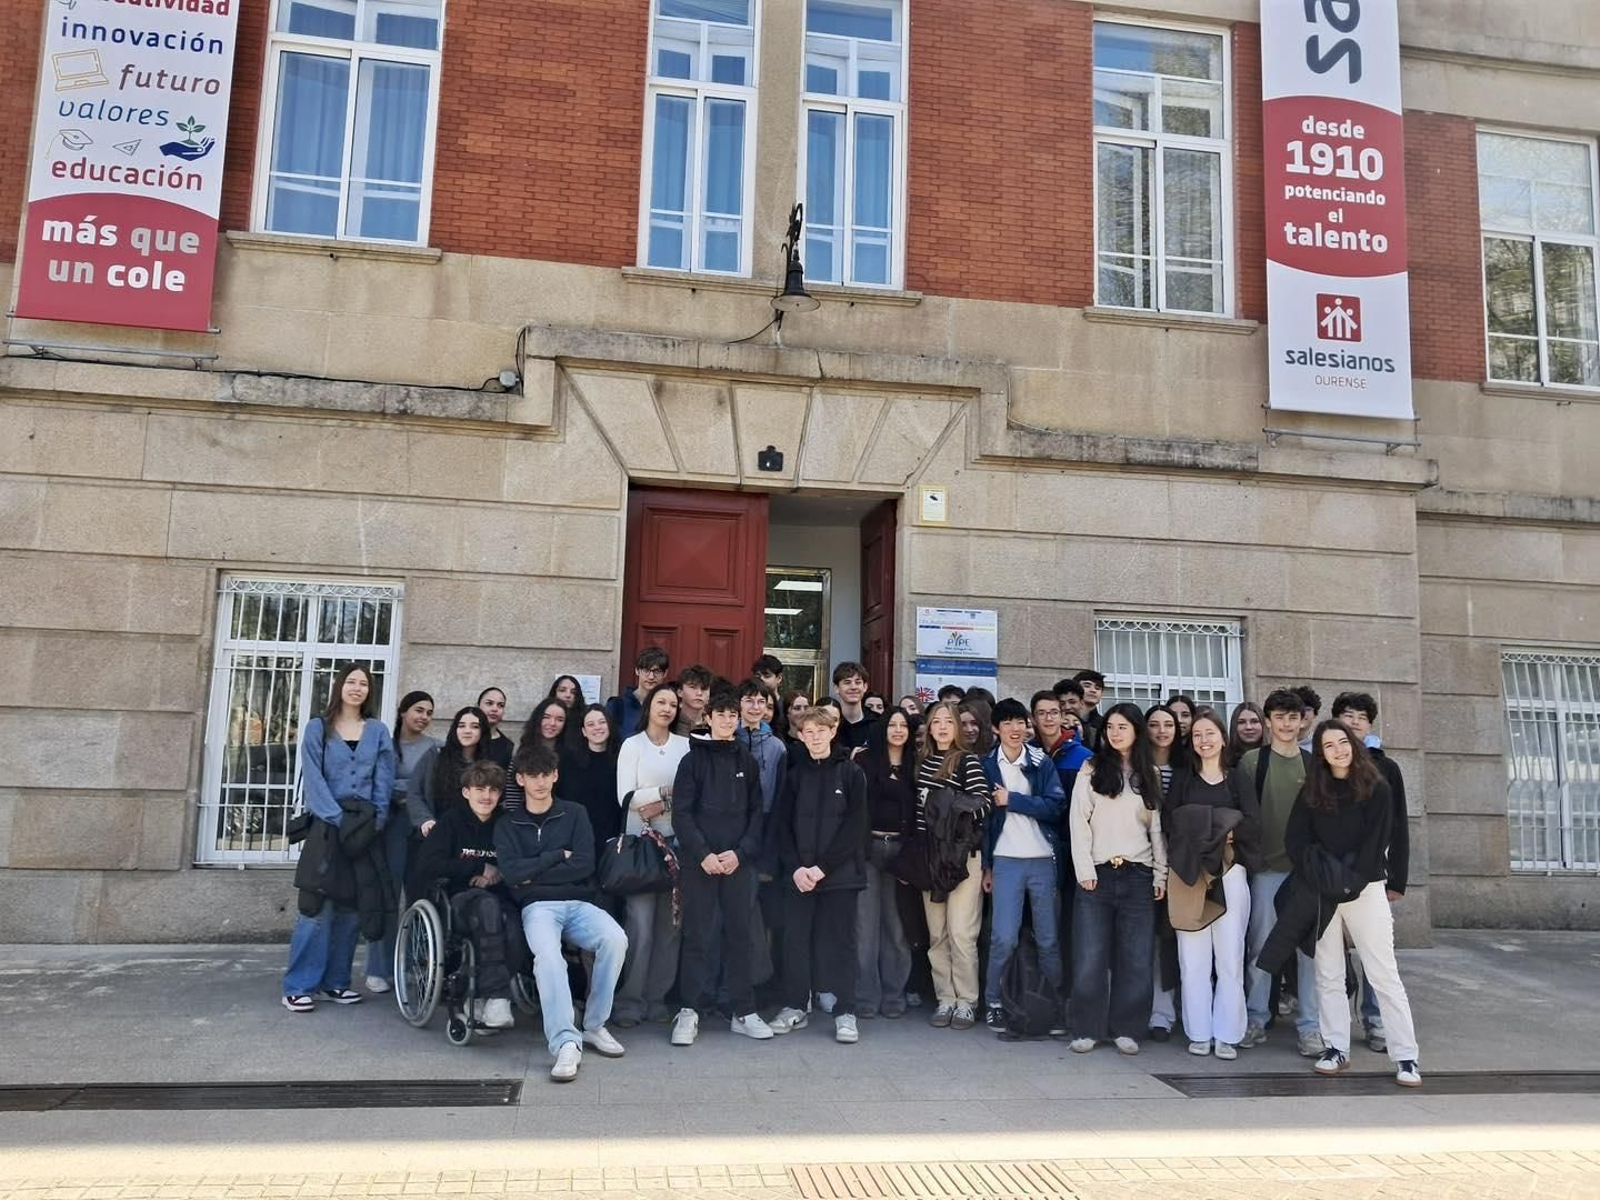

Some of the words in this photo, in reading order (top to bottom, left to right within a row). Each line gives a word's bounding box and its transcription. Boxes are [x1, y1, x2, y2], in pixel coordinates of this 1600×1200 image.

[114, 0, 230, 16] vidad
[61, 16, 223, 54] innovación
[118, 64, 221, 95] futuro
[58, 99, 169, 126] valores
[1302, 116, 1365, 139] desde
[51, 157, 203, 191] educación
[1285, 140, 1384, 181] 1910
[1285, 184, 1386, 205] potenciando
[1328, 208, 1343, 223] el
[42, 215, 117, 245] más
[131, 225, 200, 256] que
[1284, 222, 1388, 253] talento
[48, 259, 94, 284] un
[107, 261, 185, 291] cole
[1285, 347, 1395, 373] salesianos
[1315, 375, 1367, 389] OURENSE
